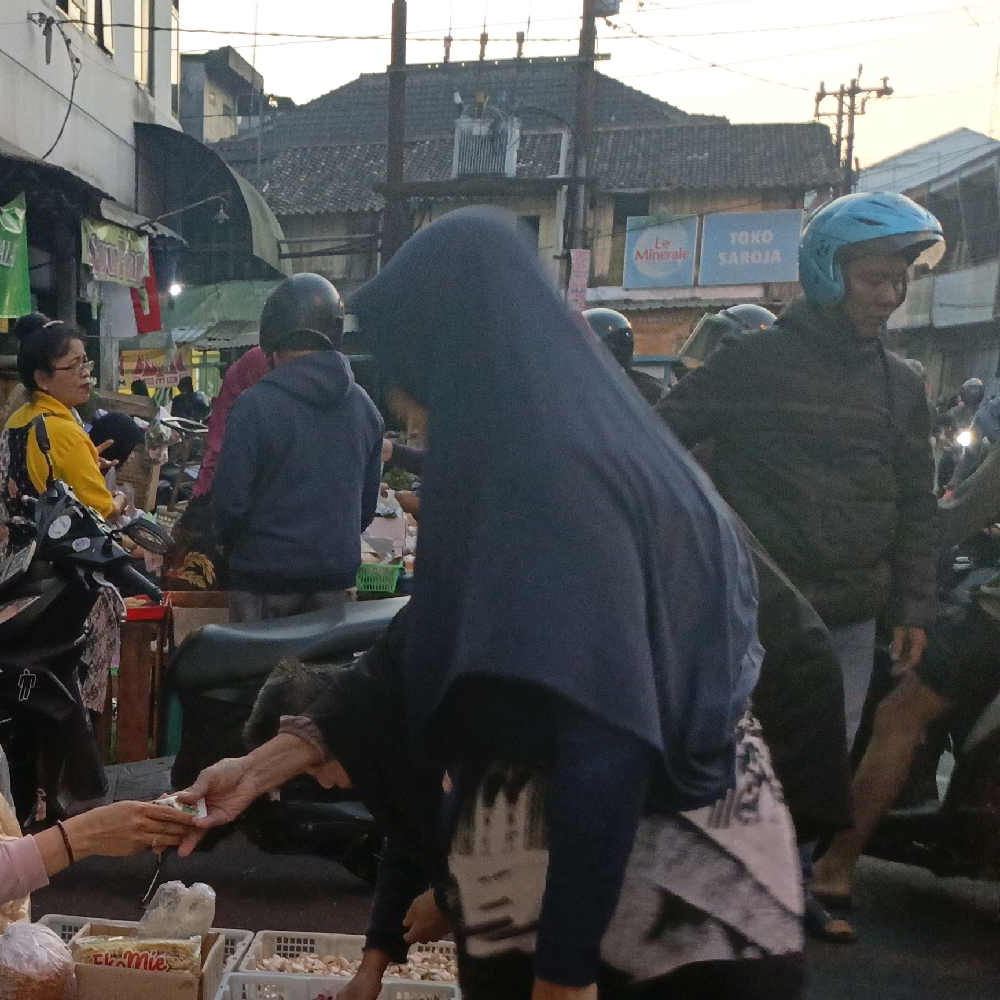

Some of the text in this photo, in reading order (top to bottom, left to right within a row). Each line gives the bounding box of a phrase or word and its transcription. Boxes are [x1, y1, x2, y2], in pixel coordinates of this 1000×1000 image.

[655, 237, 670, 249] Le
[730, 230, 773, 245] TOKO
[635, 248, 690, 261] Minerale
[719, 251, 782, 266] SAROJA
[122, 949, 170, 972] Mie
